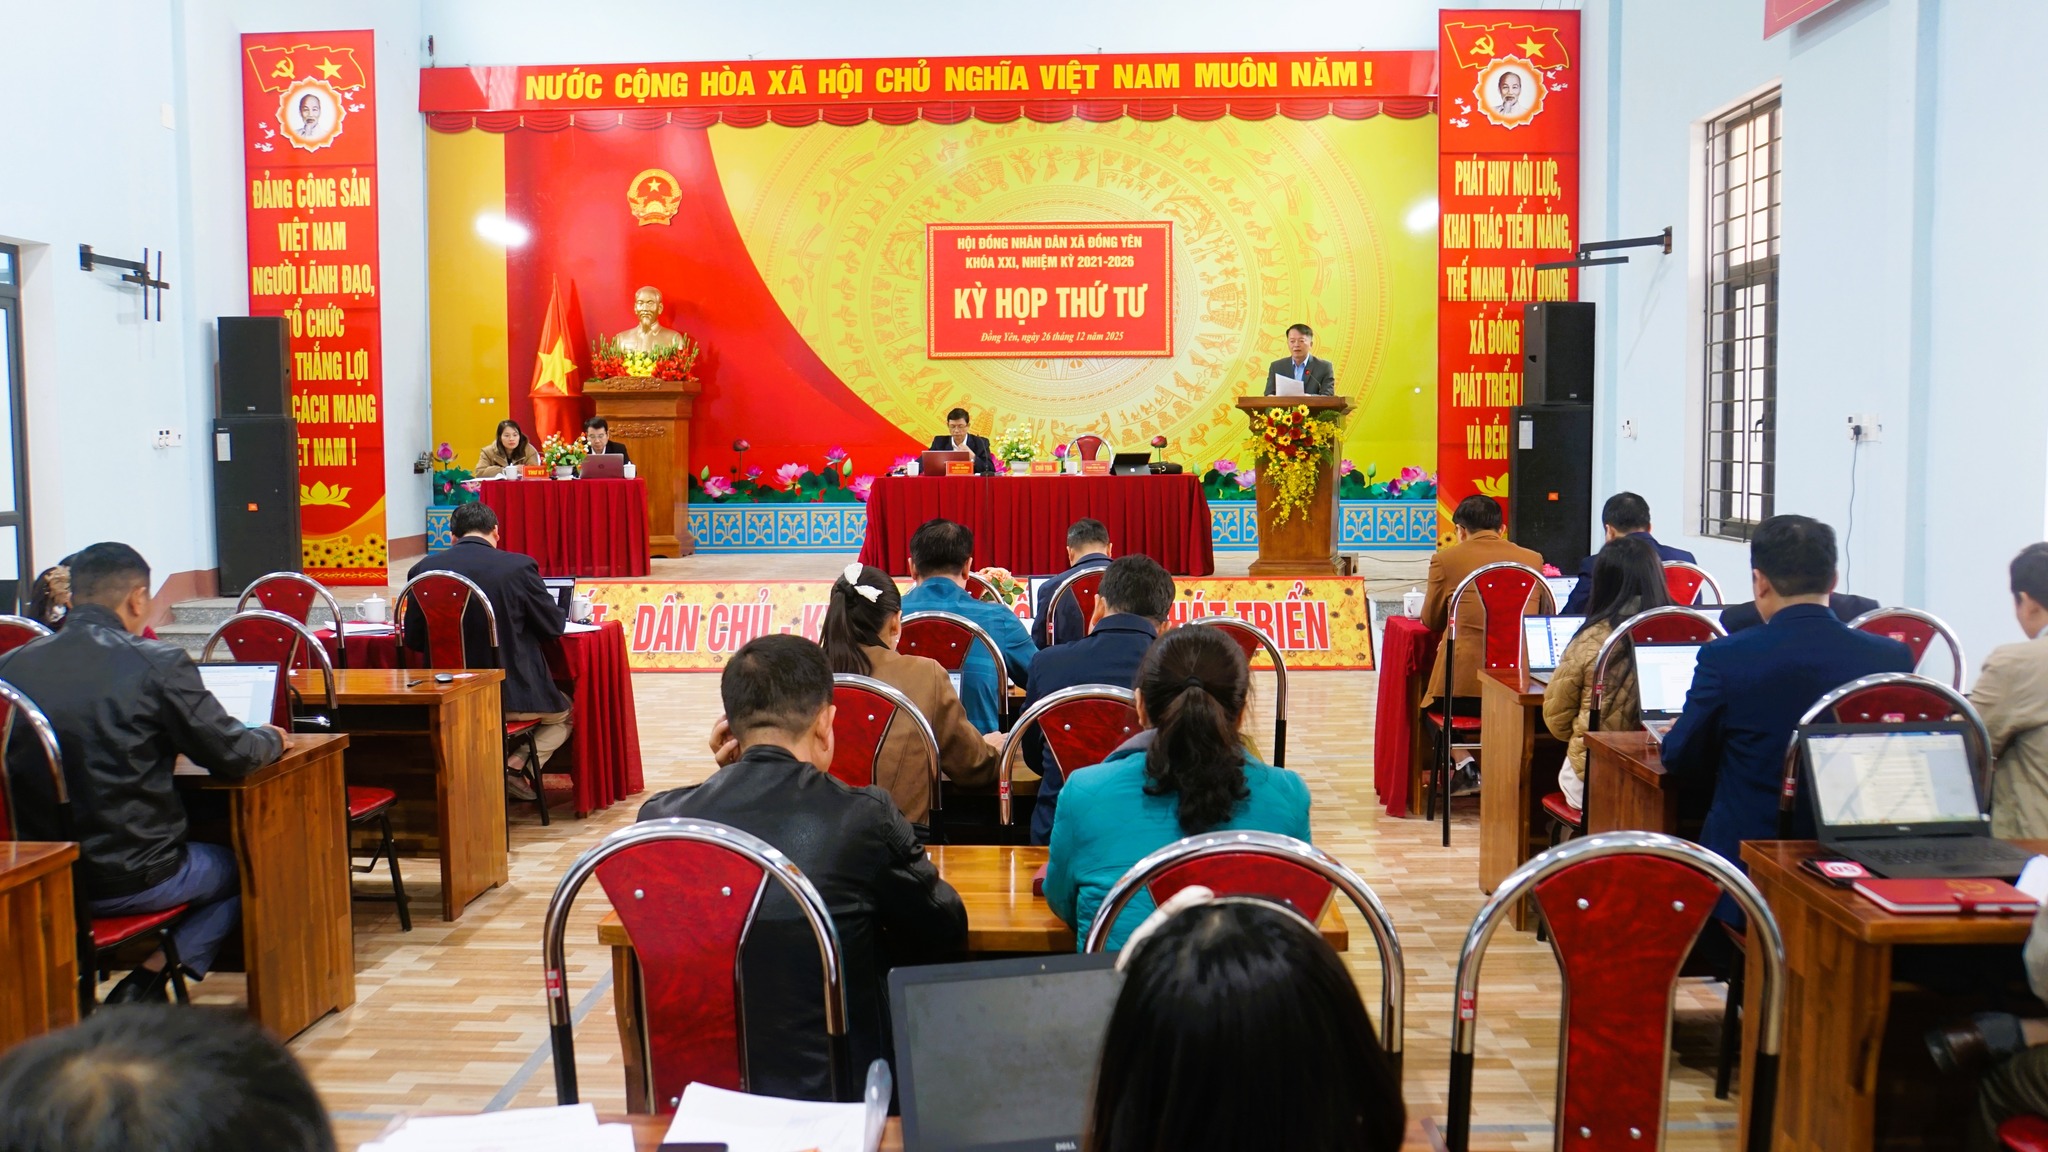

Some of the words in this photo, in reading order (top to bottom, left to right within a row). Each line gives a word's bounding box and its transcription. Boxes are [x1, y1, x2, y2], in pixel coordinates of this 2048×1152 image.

[526, 67, 602, 100] NƯỚC
[615, 67, 688, 103] CỘNG
[701, 65, 755, 96] HÒA
[768, 65, 806, 95] XÃ
[819, 63, 862, 98] HỘI
[876, 58, 931, 92] CHỦ
[945, 60, 1029, 91] NGHĨA
[1040, 59, 1099, 94] VIỆT
[1114, 63, 1180, 89] NAM
[1195, 57, 1277, 88] MUÔN
[252, 170, 293, 209] ĐẢNG
[296, 172, 336, 214] CỘNG
[340, 168, 371, 207] SẢN
[1455, 153, 1485, 196] PHÁT
[1488, 161, 1510, 196] HUY
[1513, 153, 1533, 204] NỘI
[1536, 158, 1561, 204] LỰC,
[278, 216, 309, 258] VIỆT
[312, 222, 347, 251] NAM
[957, 235, 975, 252] HỘI
[979, 235, 1009, 249] ĐỒNG
[1011, 235, 1042, 249] NHÂN
[1045, 235, 1067, 248] DÂN
[1070, 234, 1085, 248] XÃ
[1088, 233, 1118, 248] ĐỒNG
[1121, 233, 1142, 248] YÊN
[1443, 214, 1470, 249] KHAI
[1474, 206, 1502, 249] THÁC
[1506, 202, 1533, 249] TIỀM
[1537, 206, 1572, 253] NĂNG,
[252, 259, 297, 295] NGƯỜI
[301, 260, 338, 294] LÃNH
[342, 264, 375, 300] ĐẠO,
[966, 255, 995, 269] KHÓA
[998, 256, 1019, 269] XXI,
[1022, 254, 1058, 270] NHIỆM
[1060, 253, 1075, 268] KỲ
[1077, 256, 1134, 268] 2021-2026
[1447, 255, 1469, 302] THẾ
[1471, 267, 1508, 310] MẠNH,
[1511, 259, 1535, 302] XÂY
[306, 303, 344, 338] CHỨC
[954, 281, 987, 319] KỲ
[996, 287, 1048, 325] HỌP
[1056, 280, 1108, 318] THỨ
[1113, 283, 1148, 318] TƯ
[1003, 332, 1020, 342] Yên,
[1021, 332, 1040, 342] ngày
[1041, 332, 1051, 341] 26
[1052, 332, 1074, 342] tháng
[1076, 331, 1085, 340] 12
[1086, 332, 1103, 340] năm
[1105, 331, 1124, 340] 2025
[1469, 313, 1485, 355] XÃ
[1488, 307, 1520, 355] ĐỒNG
[295, 341, 342, 380] THẮNG
[346, 348, 368, 386] LỢI
[1452, 365, 1482, 407] PHÁT
[1485, 358, 1518, 407] TRIỂN
[292, 389, 329, 423] CÁCH
[334, 393, 376, 430] MẠNG
[314, 437, 347, 466] NAM
[1467, 417, 1481, 460] VÀ
[1485, 414, 1508, 460] BỀN
[632, 593, 702, 653] DÂN
[708, 587, 773, 653] CHỦ
